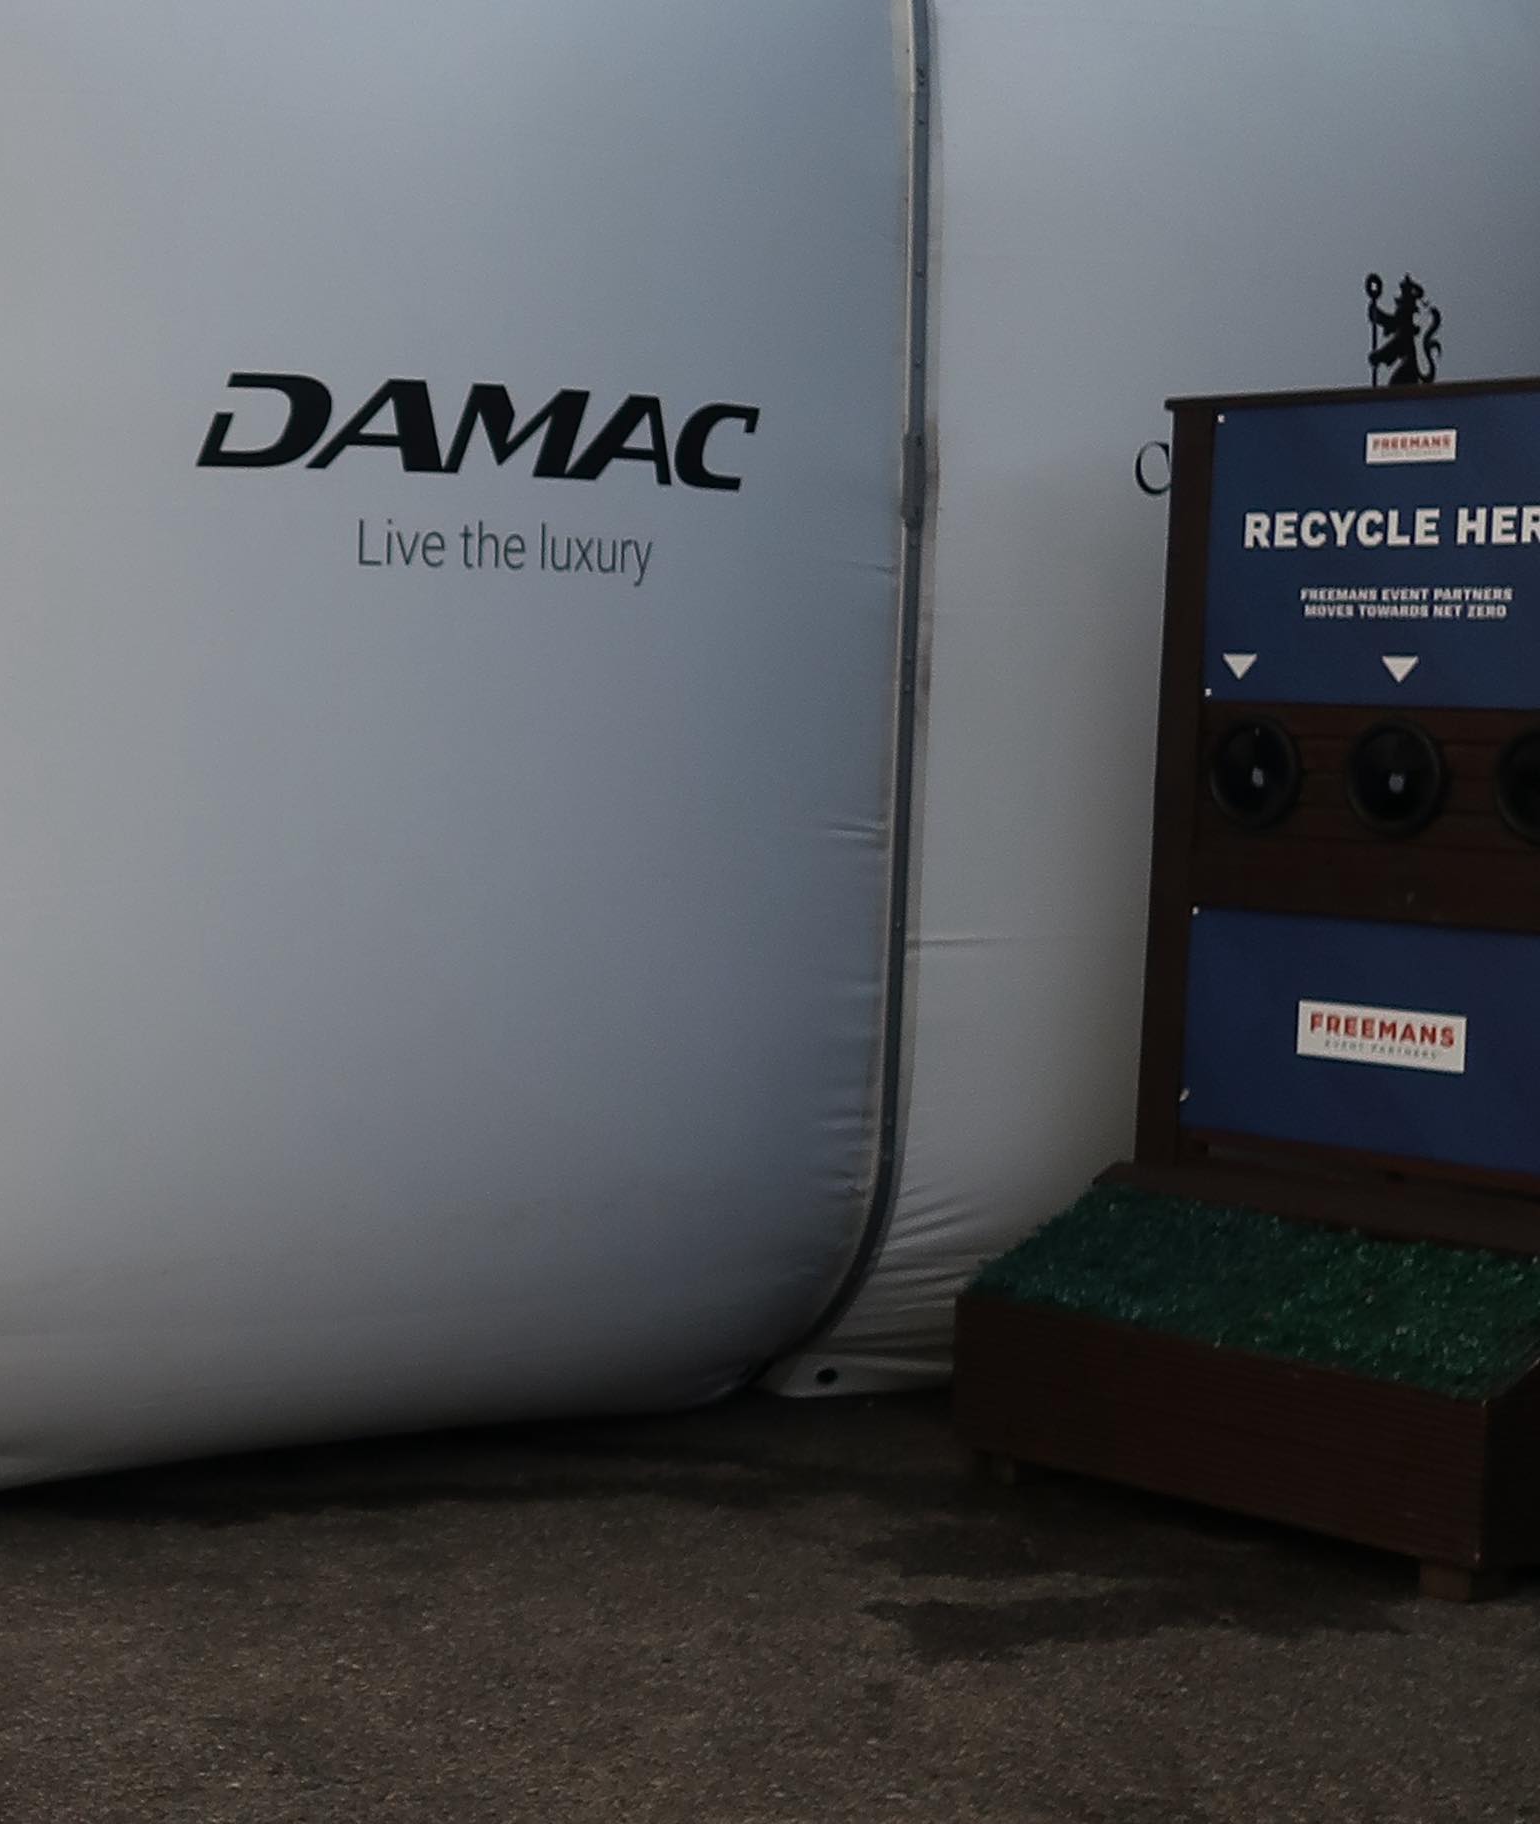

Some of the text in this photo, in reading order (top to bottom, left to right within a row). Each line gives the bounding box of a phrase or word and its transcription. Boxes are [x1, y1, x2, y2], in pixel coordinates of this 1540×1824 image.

[197, 373, 760, 492] DAMAC
[1372, 435, 1452, 450] FREEMANS
[1244, 505, 1540, 548] RECYCLE HER
[358, 519, 653, 587] Live the luxury
[1300, 586, 1513, 603] FREEMANS EVENT PARTNERS
[1303, 603, 1507, 619] MOVES TOWARDS NET ZERO
[1310, 1012, 1455, 1049] FREEMANS
